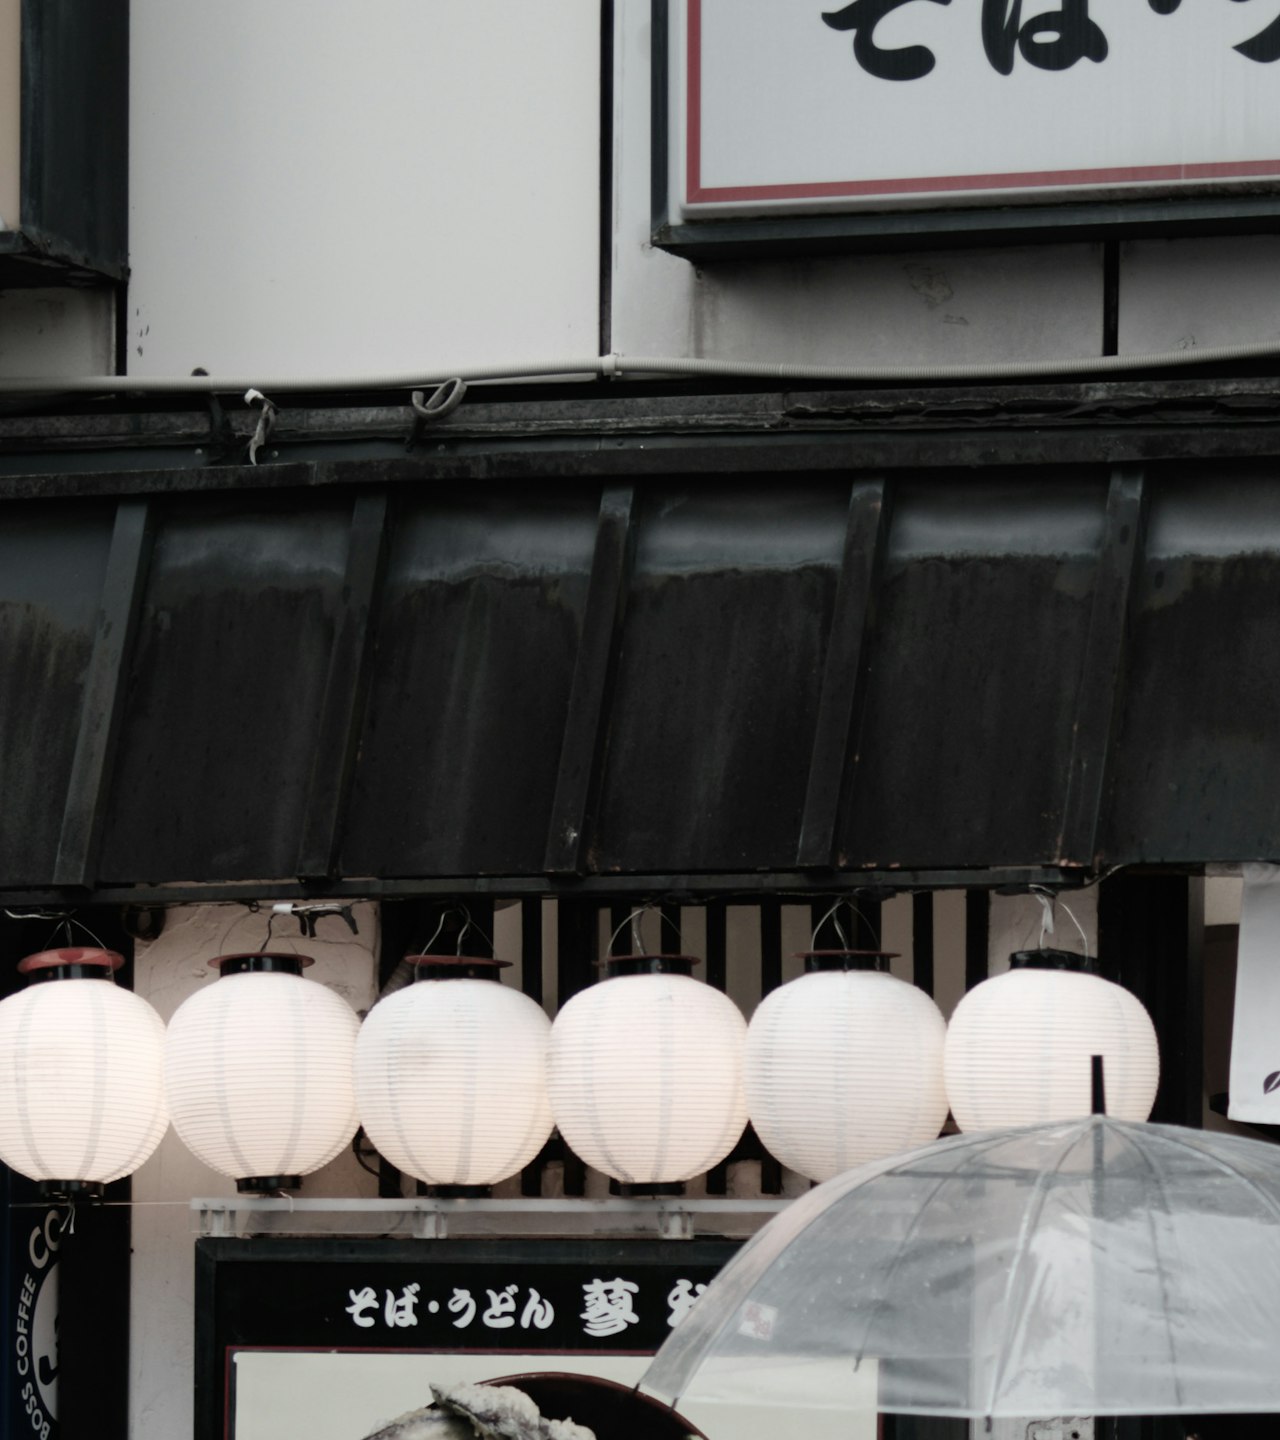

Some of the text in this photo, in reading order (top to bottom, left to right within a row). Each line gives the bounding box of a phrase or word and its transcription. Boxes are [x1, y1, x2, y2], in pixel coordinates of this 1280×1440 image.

[16, 1273, 36, 1376] COFFEE
[345, 1283, 555, 1330] そば・うどん
